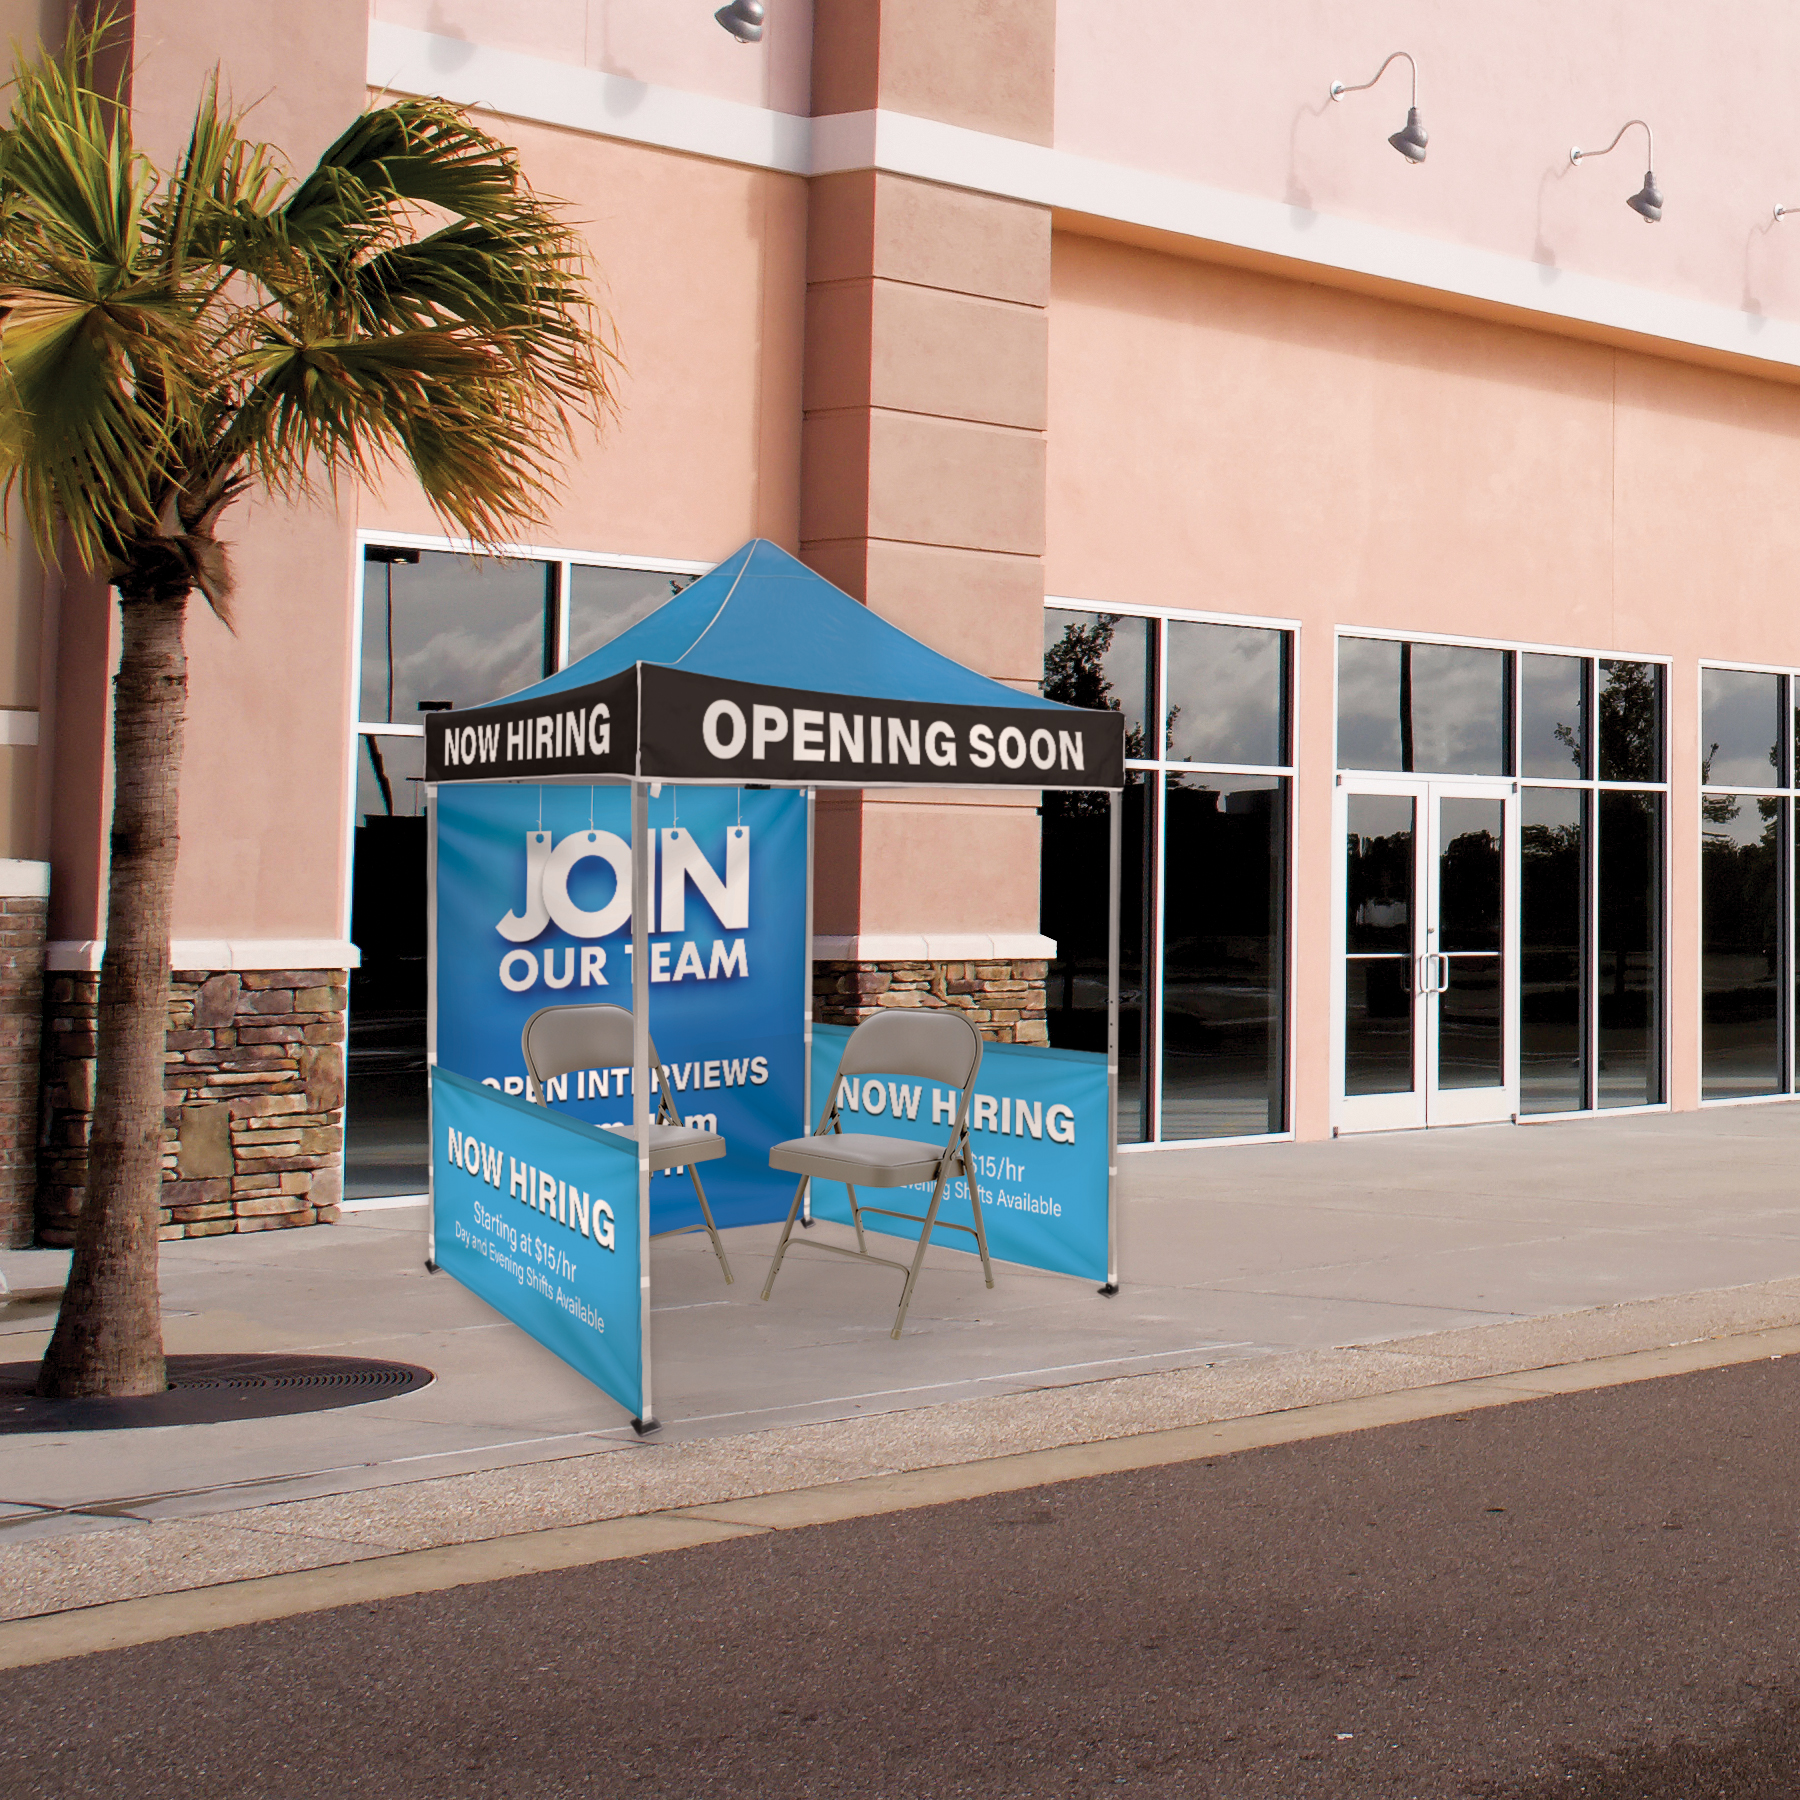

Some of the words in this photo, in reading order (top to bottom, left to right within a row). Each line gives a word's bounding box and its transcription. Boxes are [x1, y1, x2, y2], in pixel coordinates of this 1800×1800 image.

[444, 723, 500, 766] NOW
[507, 703, 611, 761] HIRING
[702, 699, 957, 766] OPENING
[968, 723, 1085, 771] SOON
[499, 946, 609, 992] OUR
[577, 1056, 769, 1100] INTRVIEWS
[837, 1075, 922, 1121] NOW
[448, 1126, 503, 1190] NOW
[509, 1156, 615, 1253] HIRING
[996, 1189, 1062, 1217] Available
[473, 1200, 517, 1252] Starting
[520, 1232, 533, 1257] at
[534, 1235, 577, 1283] $15/hr
[455, 1220, 471, 1249] Day
[472, 1238, 487, 1256] and
[489, 1241, 524, 1285] Evening
[526, 1266, 554, 1300] Shifts
[555, 1286, 605, 1334] Available
